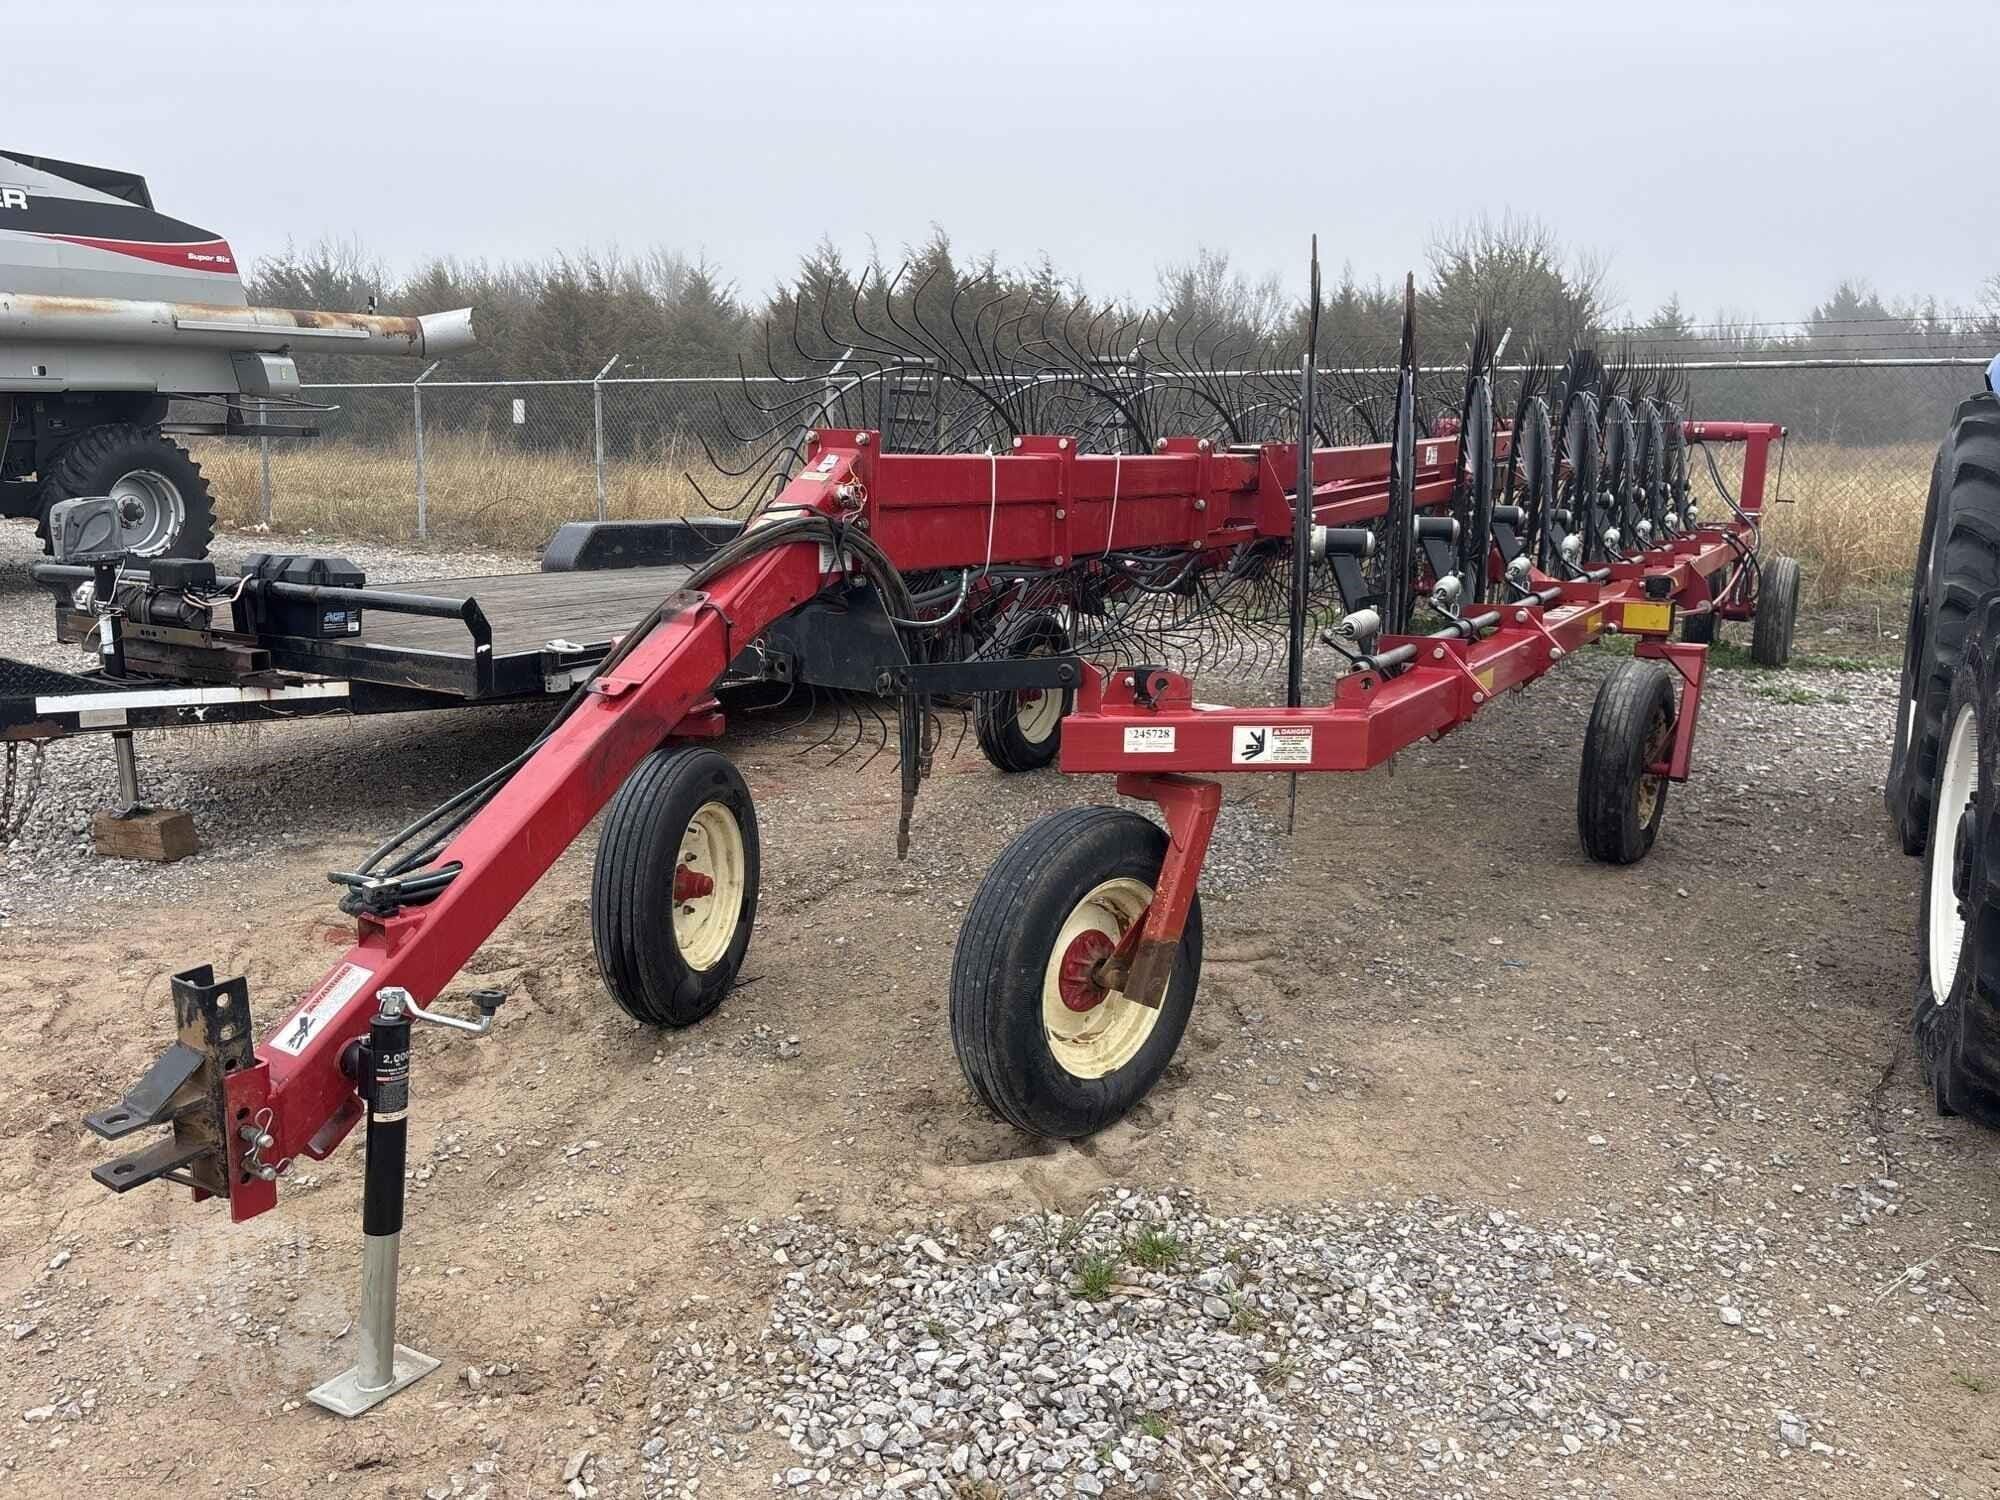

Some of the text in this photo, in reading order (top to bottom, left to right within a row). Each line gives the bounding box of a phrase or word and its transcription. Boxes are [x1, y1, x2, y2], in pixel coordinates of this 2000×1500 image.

[0, 187, 29, 210] R
[187, 252, 231, 264] Super Six
[1134, 729, 1170, 739] 245728
[313, 964, 351, 1006] WARNING
